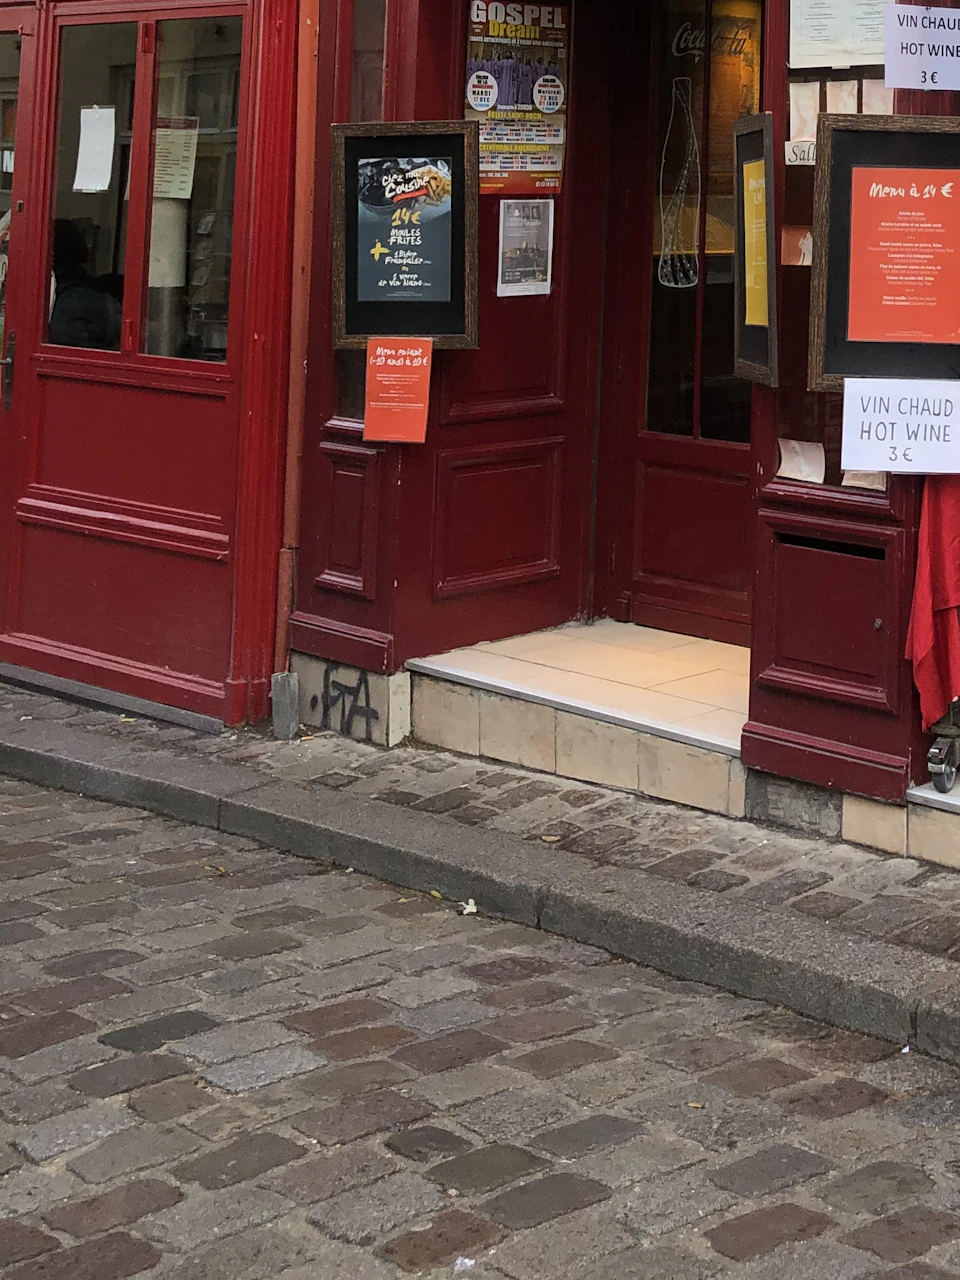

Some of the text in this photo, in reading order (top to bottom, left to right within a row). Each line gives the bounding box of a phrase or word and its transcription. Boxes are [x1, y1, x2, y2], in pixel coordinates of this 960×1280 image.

[471, 0, 566, 29] GOSPEL
[898, 14, 917, 28] VIN
[489, 20, 540, 39] Dream
[900, 43, 925, 56] HOT
[920, 71, 938, 84] 3 €
[385, 177, 430, 199] Cousine
[870, 182, 954, 199] Menu à 14 €
[390, 228, 421, 236] MOULES
[388, 236, 422, 245] FRITES
[376, 346, 423, 357] Menu enfant
[860, 396, 954, 417] VIN CHAUD
[860, 420, 951, 443] HOT WINE
[888, 446, 913, 462] 3 €
